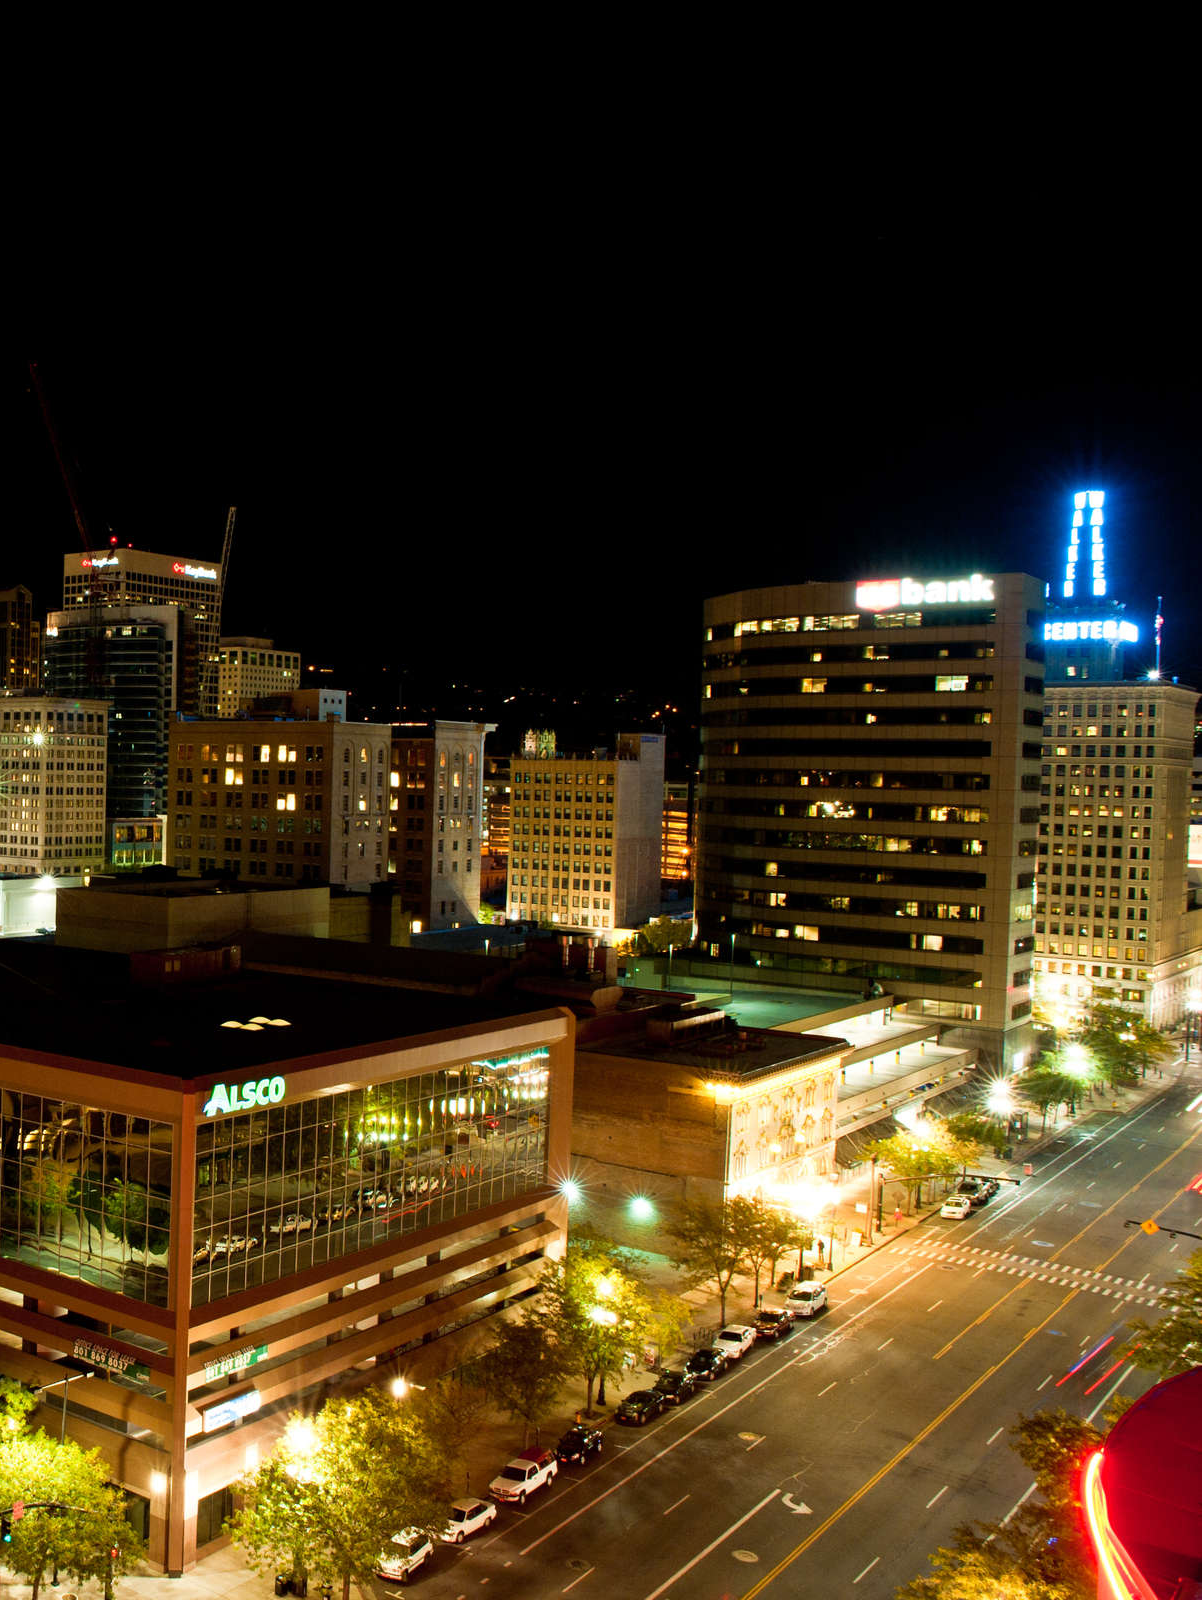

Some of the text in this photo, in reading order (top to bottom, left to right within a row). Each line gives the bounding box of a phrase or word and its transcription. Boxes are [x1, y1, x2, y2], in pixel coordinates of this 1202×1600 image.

[900, 573, 995, 604] bank
[202, 1076, 286, 1117] ALSCO
[74, 1346, 88, 1357] 801
[91, 1351, 106, 1363] 869
[108, 1357, 128, 1371] 8037
